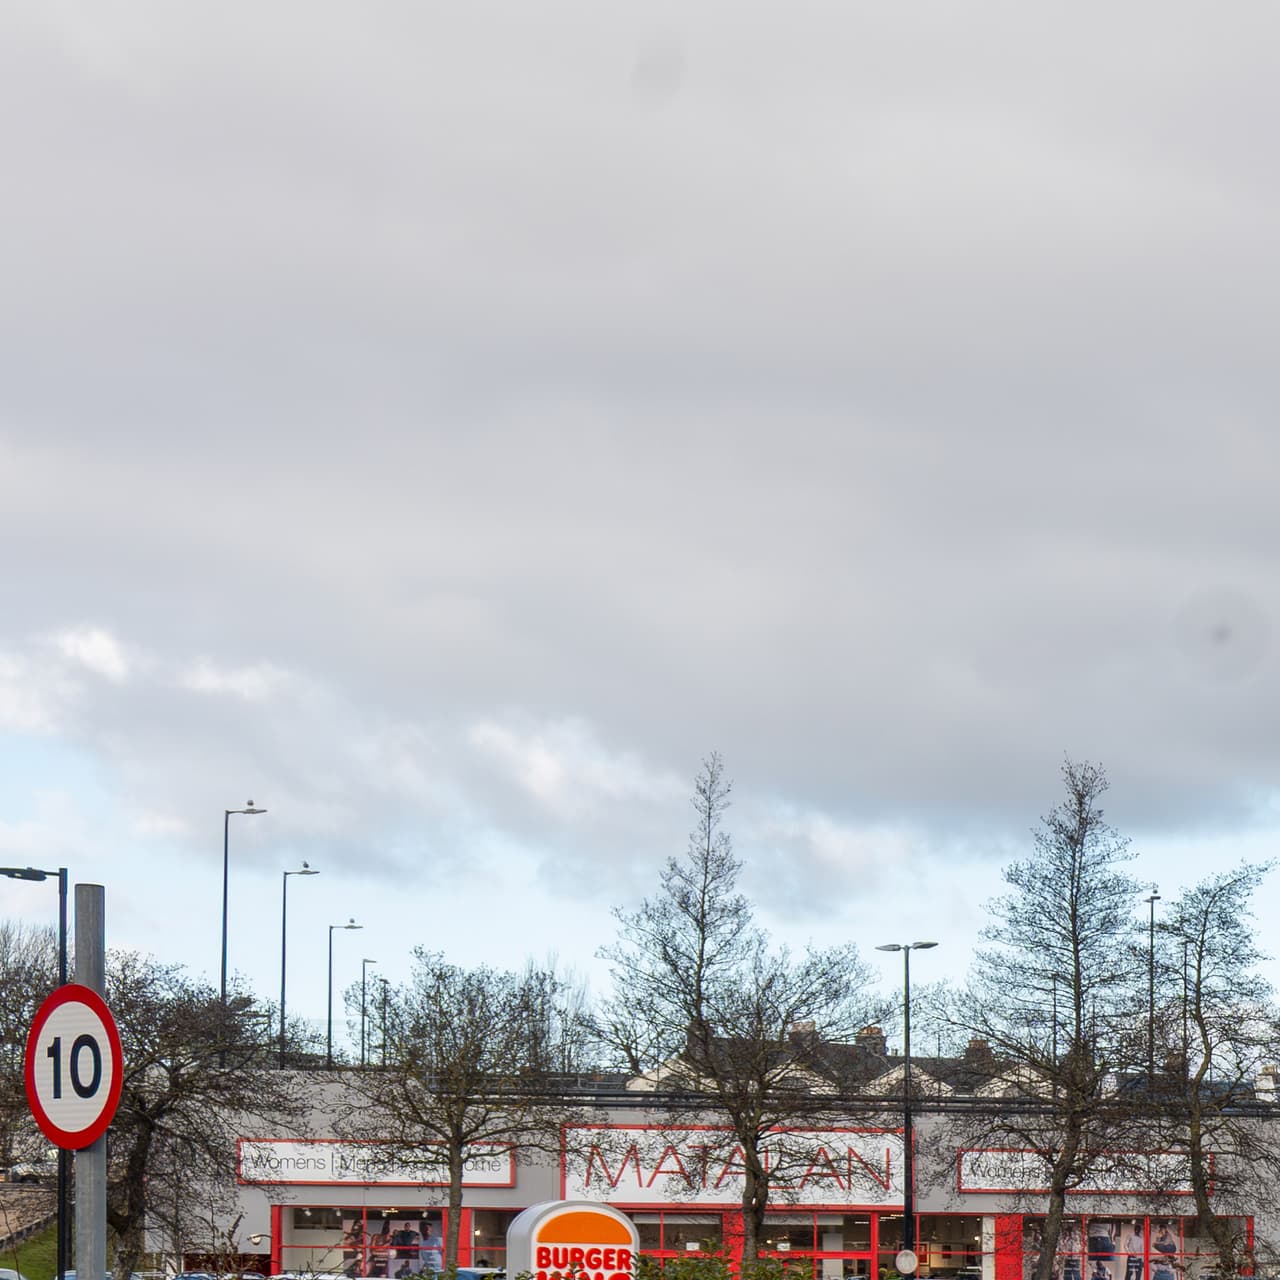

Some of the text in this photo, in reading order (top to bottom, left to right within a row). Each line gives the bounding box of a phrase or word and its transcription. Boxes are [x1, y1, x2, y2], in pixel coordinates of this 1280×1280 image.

[47, 1034, 102, 1099] 10
[585, 1145, 891, 1192] MATALAN
[536, 1247, 632, 1270] BURGER
